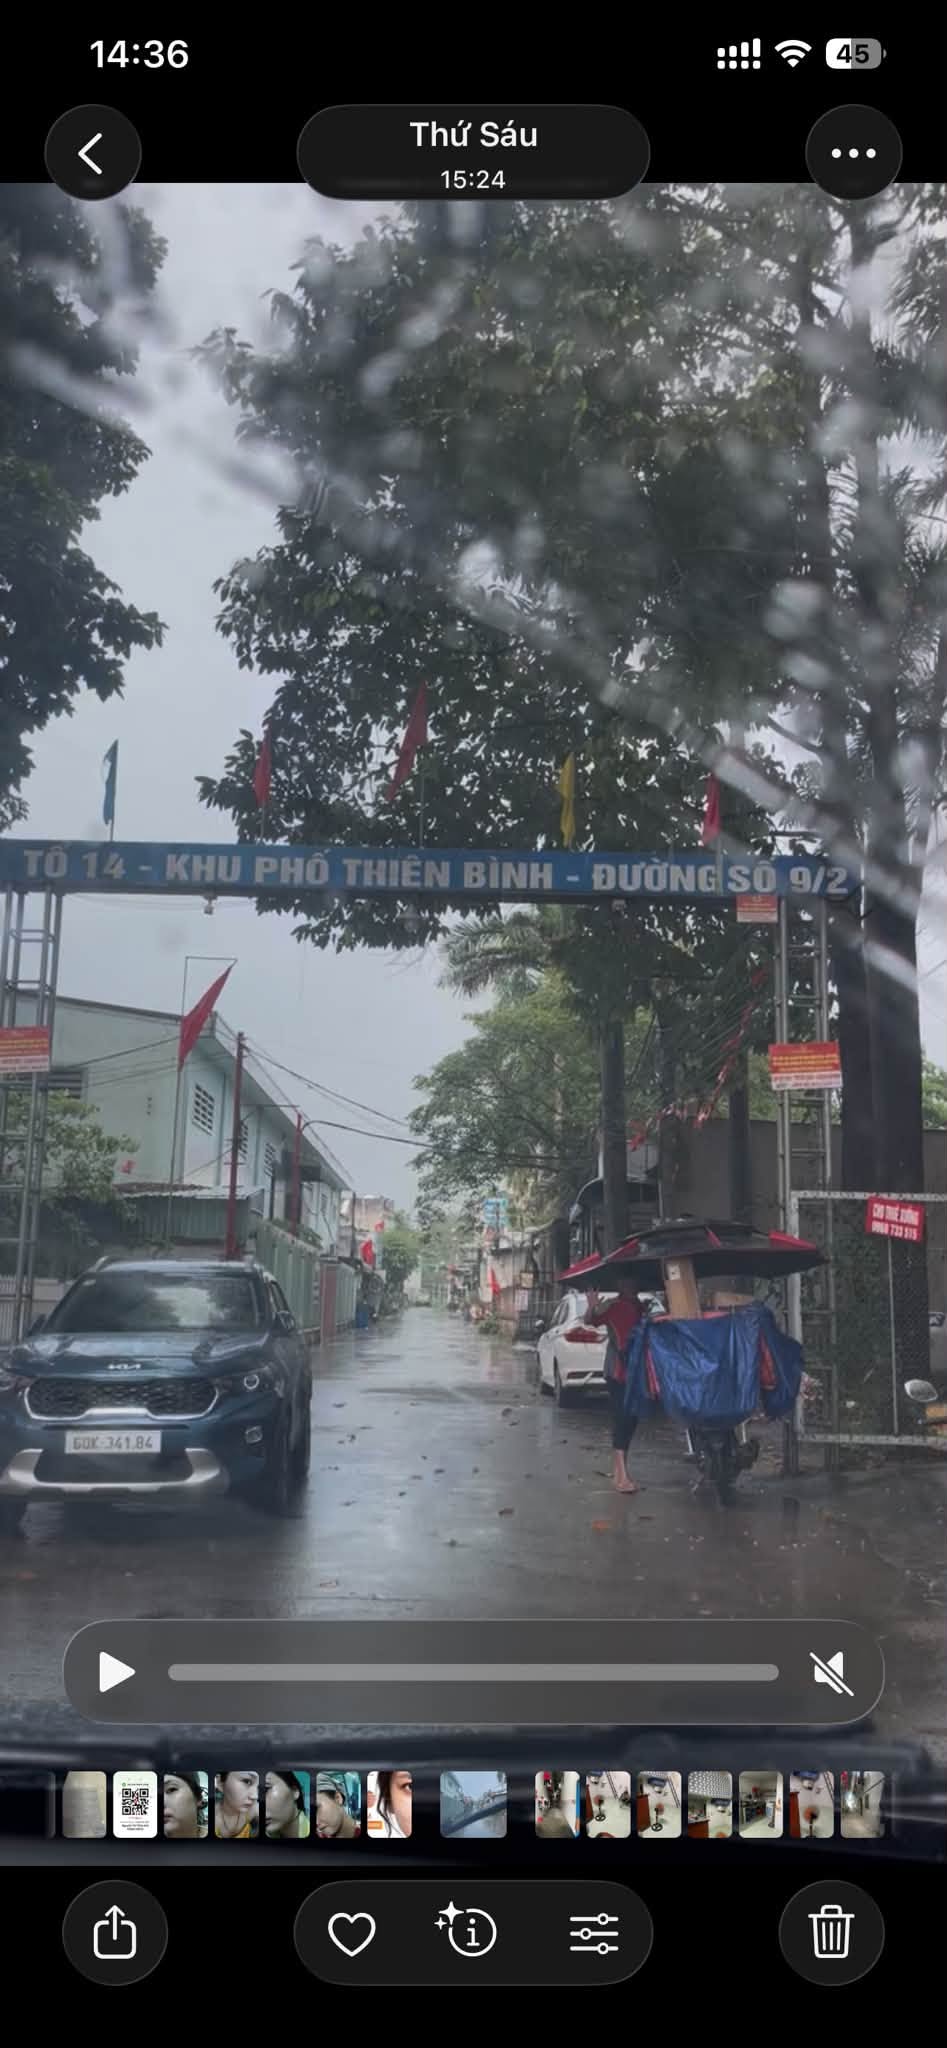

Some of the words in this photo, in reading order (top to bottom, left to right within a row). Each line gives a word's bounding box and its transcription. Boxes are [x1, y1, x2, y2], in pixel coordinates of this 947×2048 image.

[82, 852, 125, 880] 14
[165, 853, 241, 882] KHU
[254, 848, 331, 885] PHỐ
[343, 853, 449, 888] THIÊN
[463, 856, 553, 889] BÌNH
[592, 852, 717, 893] ĐƯỜNG
[789, 866, 849, 894] 9/2
